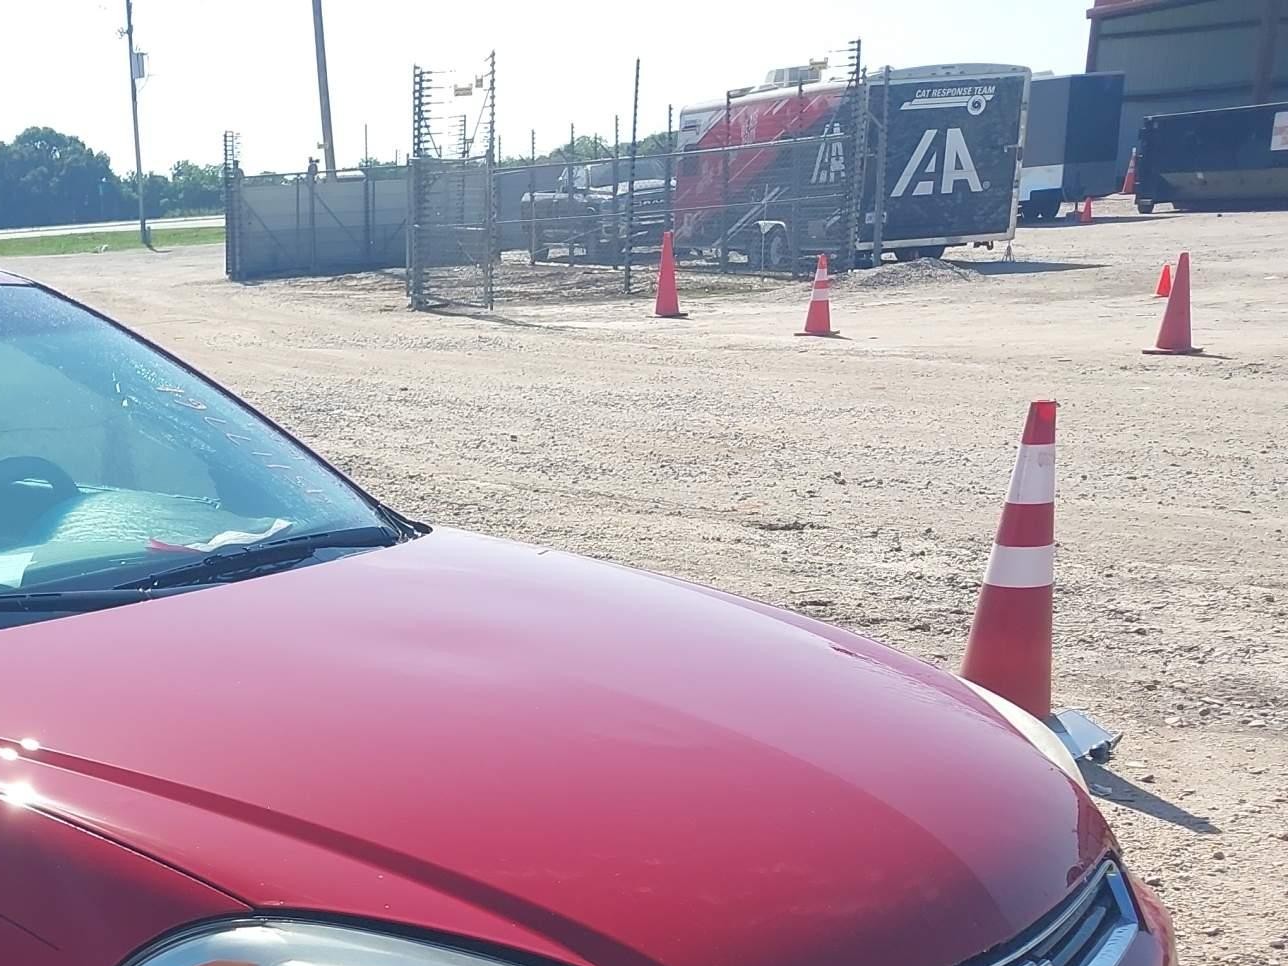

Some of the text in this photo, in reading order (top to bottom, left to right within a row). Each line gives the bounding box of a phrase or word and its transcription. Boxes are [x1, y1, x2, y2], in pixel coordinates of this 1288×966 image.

[915, 85, 996, 98] CAT RESPONSE TEAM
